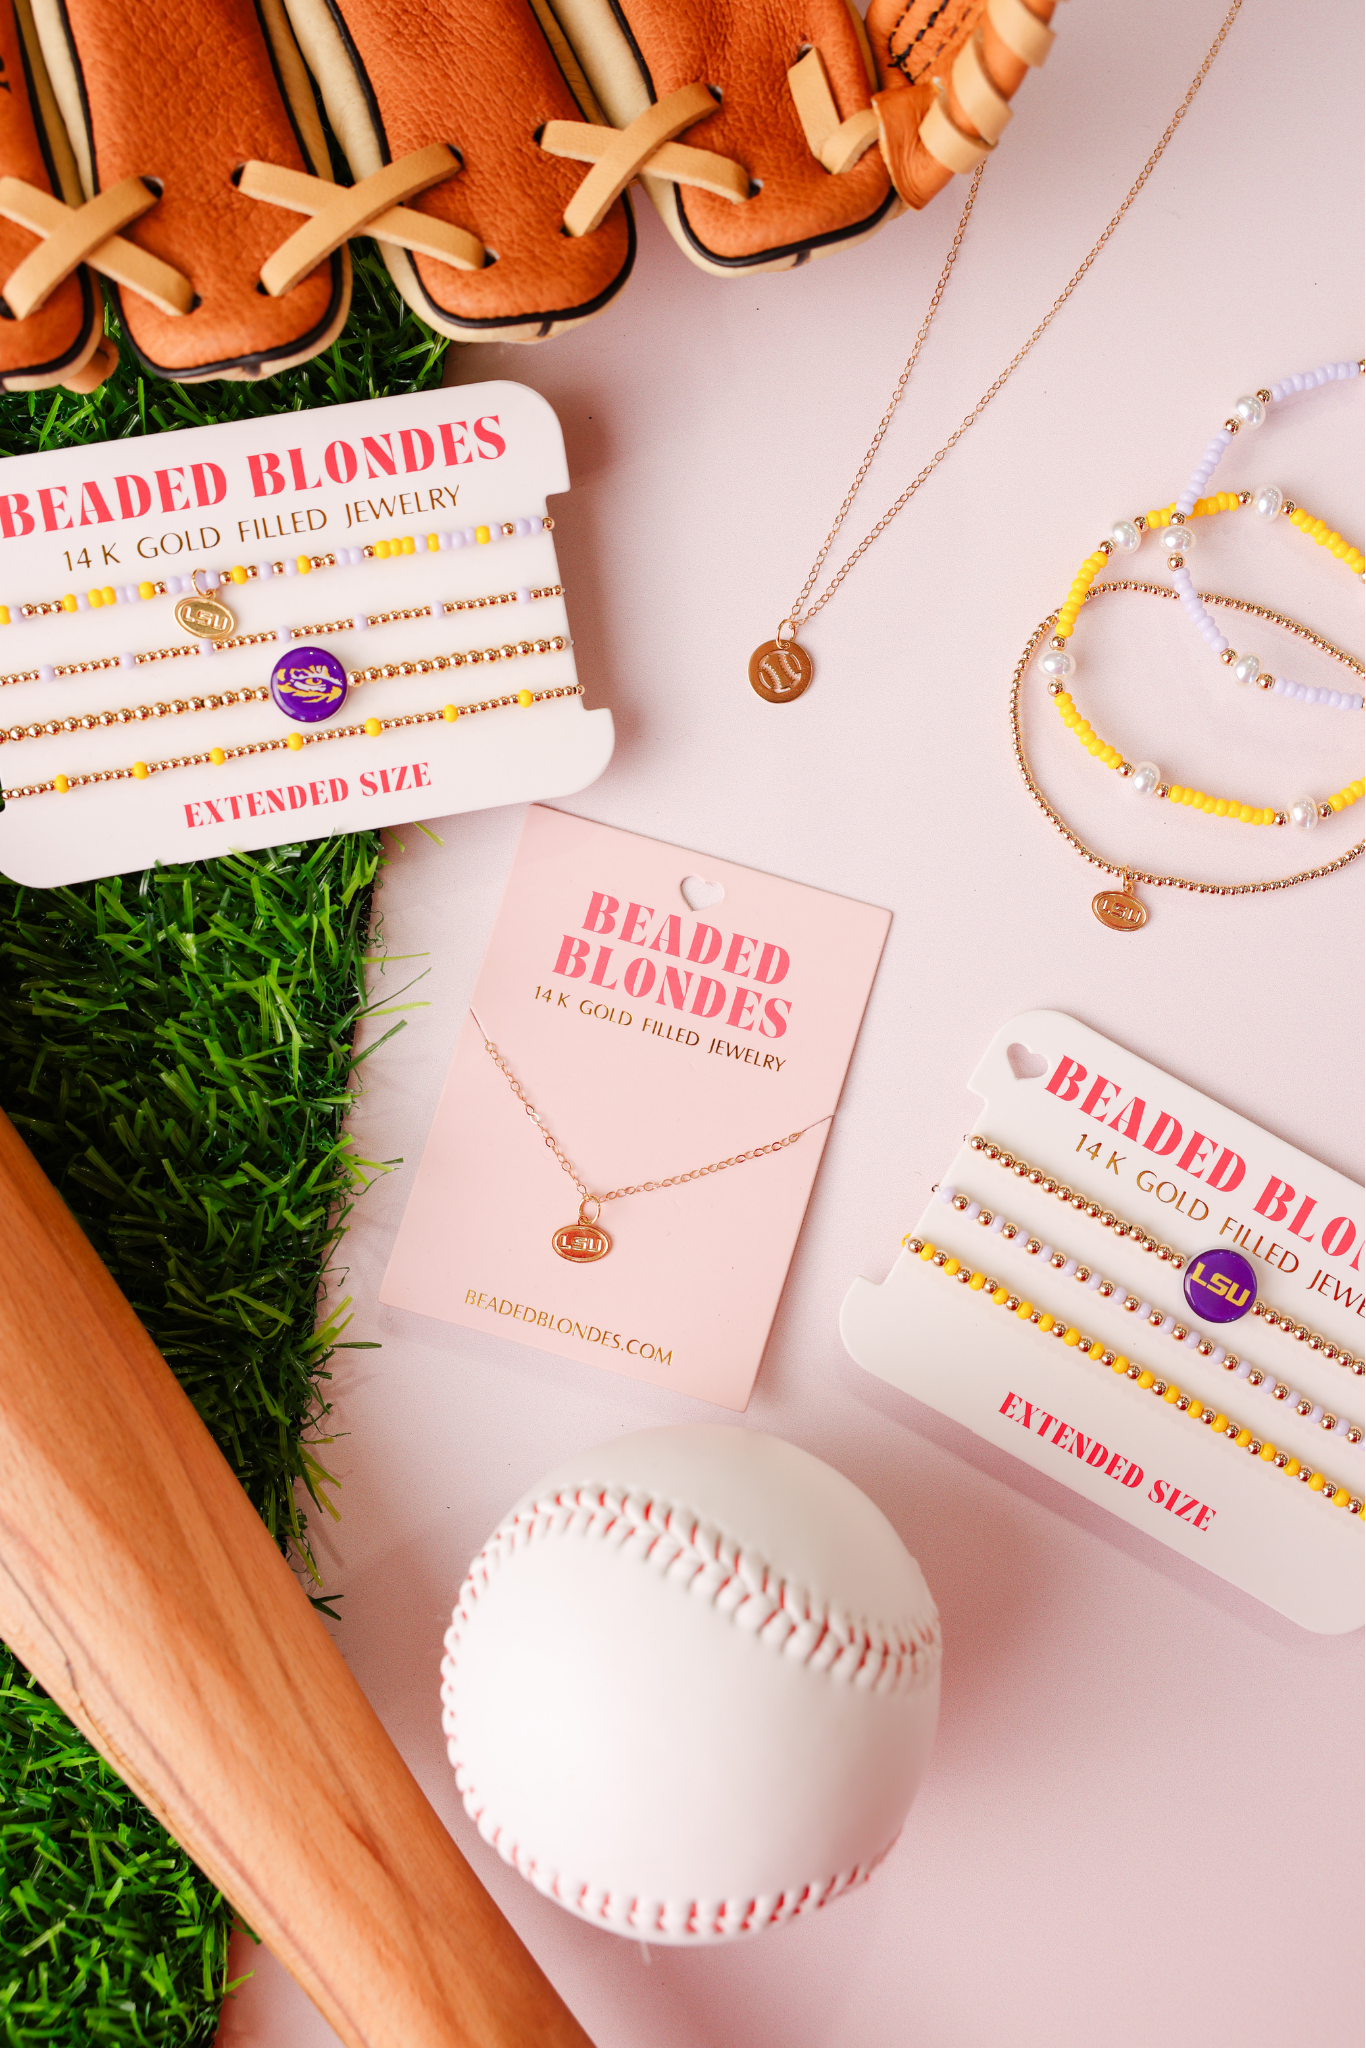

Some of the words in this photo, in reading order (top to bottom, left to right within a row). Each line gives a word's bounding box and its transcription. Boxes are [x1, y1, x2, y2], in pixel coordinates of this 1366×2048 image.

[0, 462, 227, 539] BEADED
[247, 414, 506, 498] BLONDES
[137, 527, 221, 558] GOLD
[238, 507, 327, 543] FILLED
[344, 485, 461, 528] JEWELRY
[182, 605, 228, 630] LSU
[183, 778, 349, 828] EXTENDED
[359, 762, 432, 797] SIZE
[581, 890, 791, 985] BEADED
[1100, 898, 1141, 923] LSU
[552, 934, 793, 1039] BLONDES
[579, 999, 633, 1027] GOLD
[642, 1017, 700, 1047] FILLED
[707, 1037, 787, 1072] JEWELRY
[1044, 1054, 1247, 1193] BEADED
[560, 1234, 602, 1252] LSU
[1136, 1170, 1210, 1221] GOLD
[1219, 1216, 1299, 1273] FILLED
[1190, 1261, 1251, 1307] LSU
[465, 1289, 673, 1366] BEADEDBLONDES.COM
[999, 1391, 1144, 1489] EXTENDED
[1147, 1478, 1217, 1532] SIZE
